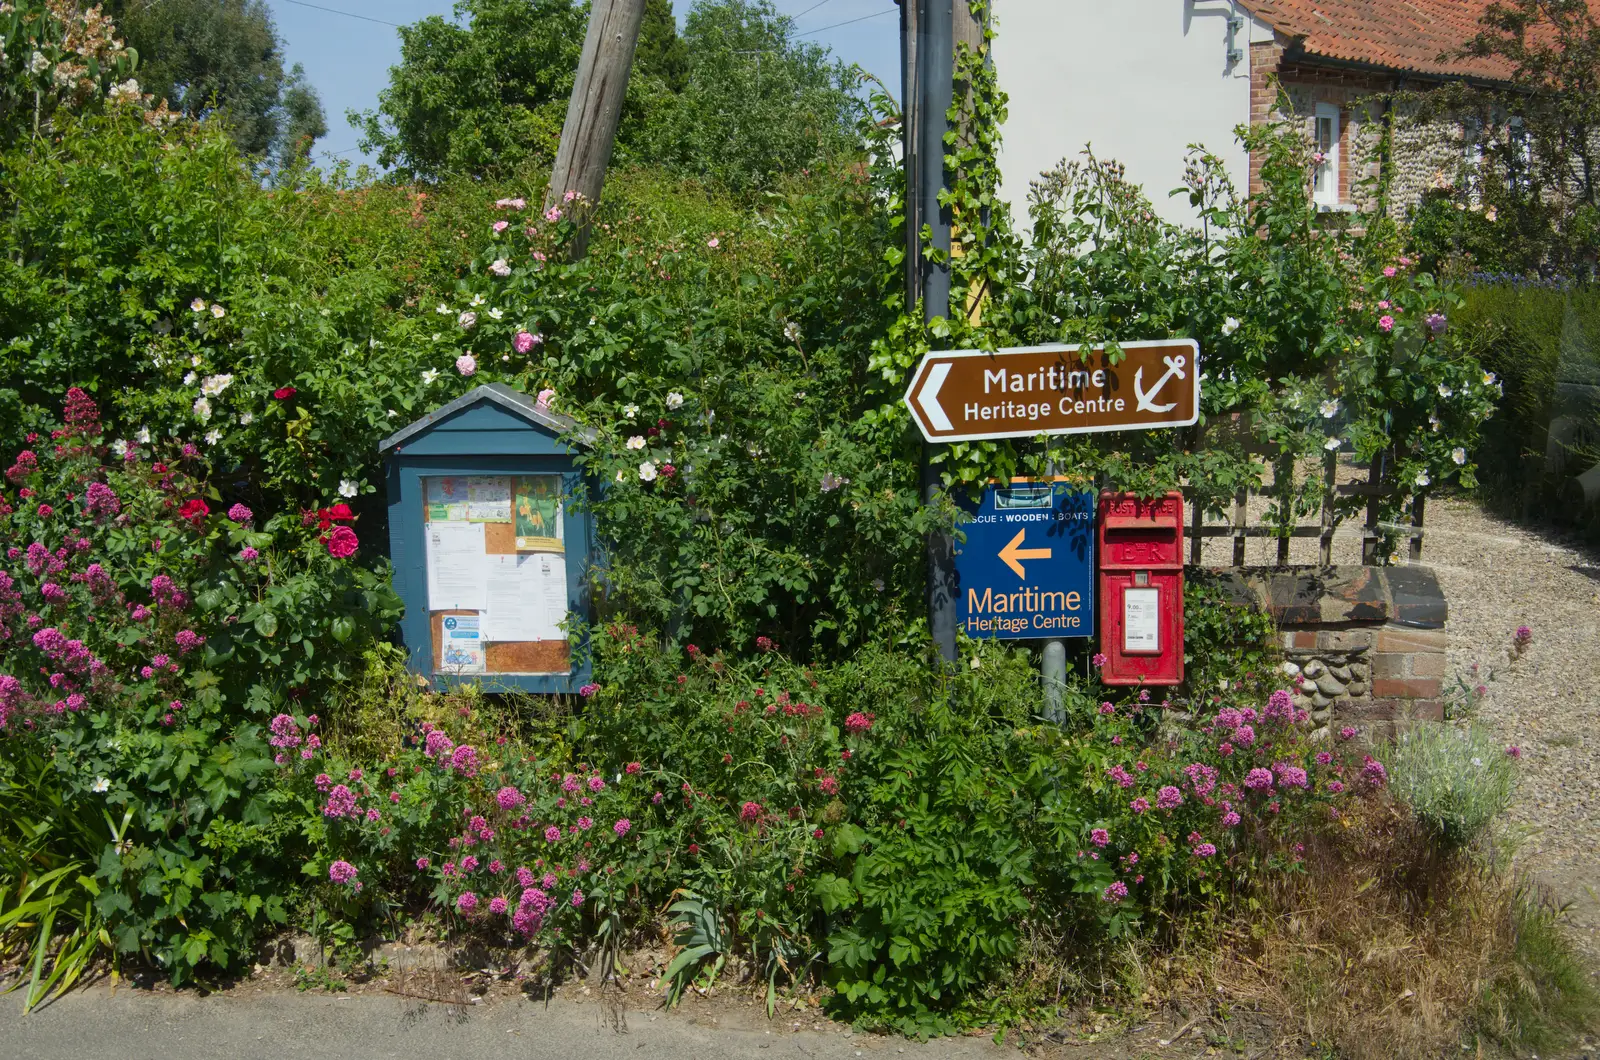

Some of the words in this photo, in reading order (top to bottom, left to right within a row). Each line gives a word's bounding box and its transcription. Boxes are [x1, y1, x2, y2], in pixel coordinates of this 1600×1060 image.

[984, 366, 1106, 393] Maritime
[964, 400, 1051, 421] Heritage
[1058, 396, 1125, 415] Centre
[962, 515, 996, 524] SCUE
[1005, 513, 1049, 523] WOODEN
[1058, 512, 1088, 521] BOATS
[1141, 502, 1173, 514] OFICE
[968, 586, 1081, 614] Maritime
[1033, 614, 1080, 629] Centre
